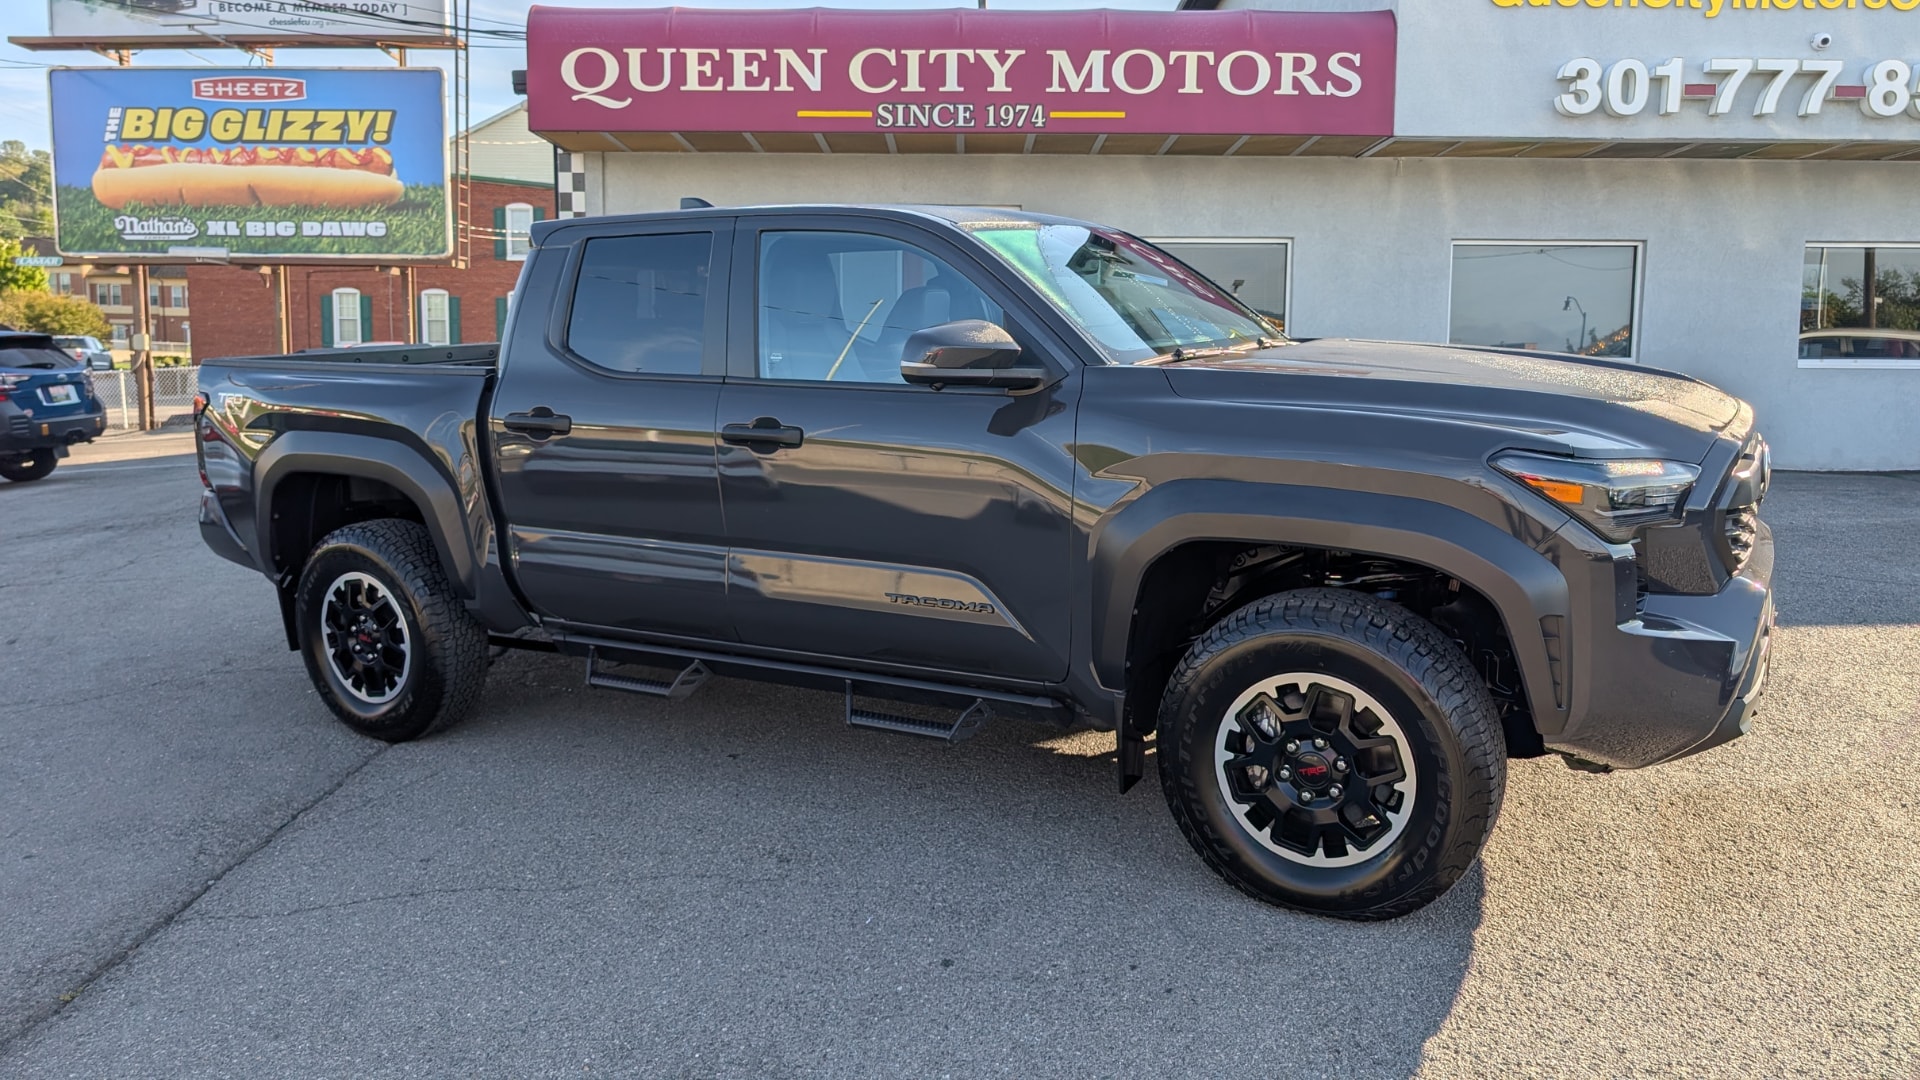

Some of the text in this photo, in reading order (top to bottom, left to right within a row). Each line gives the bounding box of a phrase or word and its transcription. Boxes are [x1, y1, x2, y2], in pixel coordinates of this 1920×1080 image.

[218, 3, 272, 13] BECOME
[278, 3, 287, 13] A
[352, 3, 398, 13] TODAY
[200, 82, 299, 97] SHEETZ
[560, 47, 1363, 110] QUEEN CITY MOTORS
[1554, 57, 1920, 119] 301-777-8
[104, 107, 122, 142] THE
[120, 107, 396, 143] BIG GLIZZY!
[876, 102, 1047, 129] SINCE 1974
[114, 215, 198, 236] Nathan's
[206, 220, 388, 238] XL BIG DAWG
[885, 592, 996, 614] TACOMA
[1299, 765, 1327, 776] TRD
